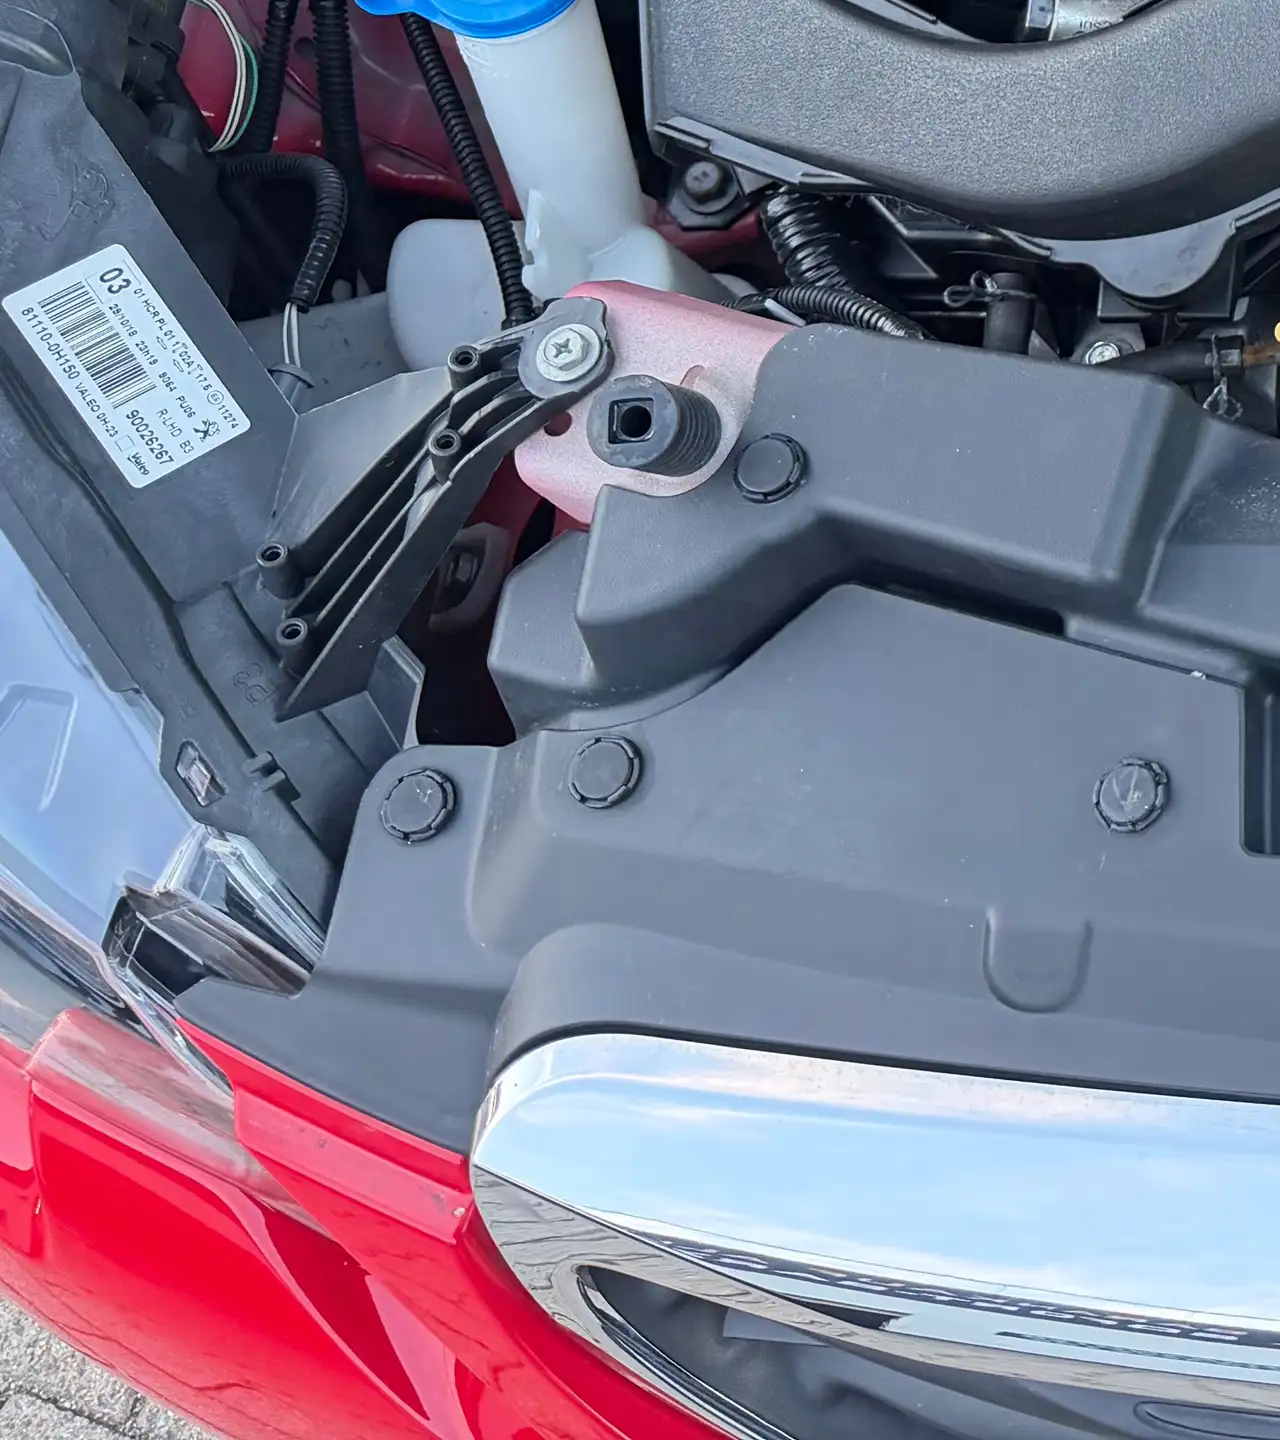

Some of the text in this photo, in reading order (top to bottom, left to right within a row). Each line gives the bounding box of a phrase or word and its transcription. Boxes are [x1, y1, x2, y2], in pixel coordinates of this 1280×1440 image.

[99, 268, 132, 294] 03
[22, 306, 80, 380] 81110-0H150
[76, 382, 100, 413] VALEO
[108, 304, 196, 418] 29/10/18 23h19 9064 PU06
[134, 288, 146, 299] 01
[142, 298, 160, 319] HCR
[154, 318, 167, 331] PL
[164, 330, 176, 340] 01
[178, 350, 195, 368] 02A
[218, 404, 240, 429] 11274
[126, 409, 174, 464] 90026267
[156, 408, 194, 454] R-LHD B3
